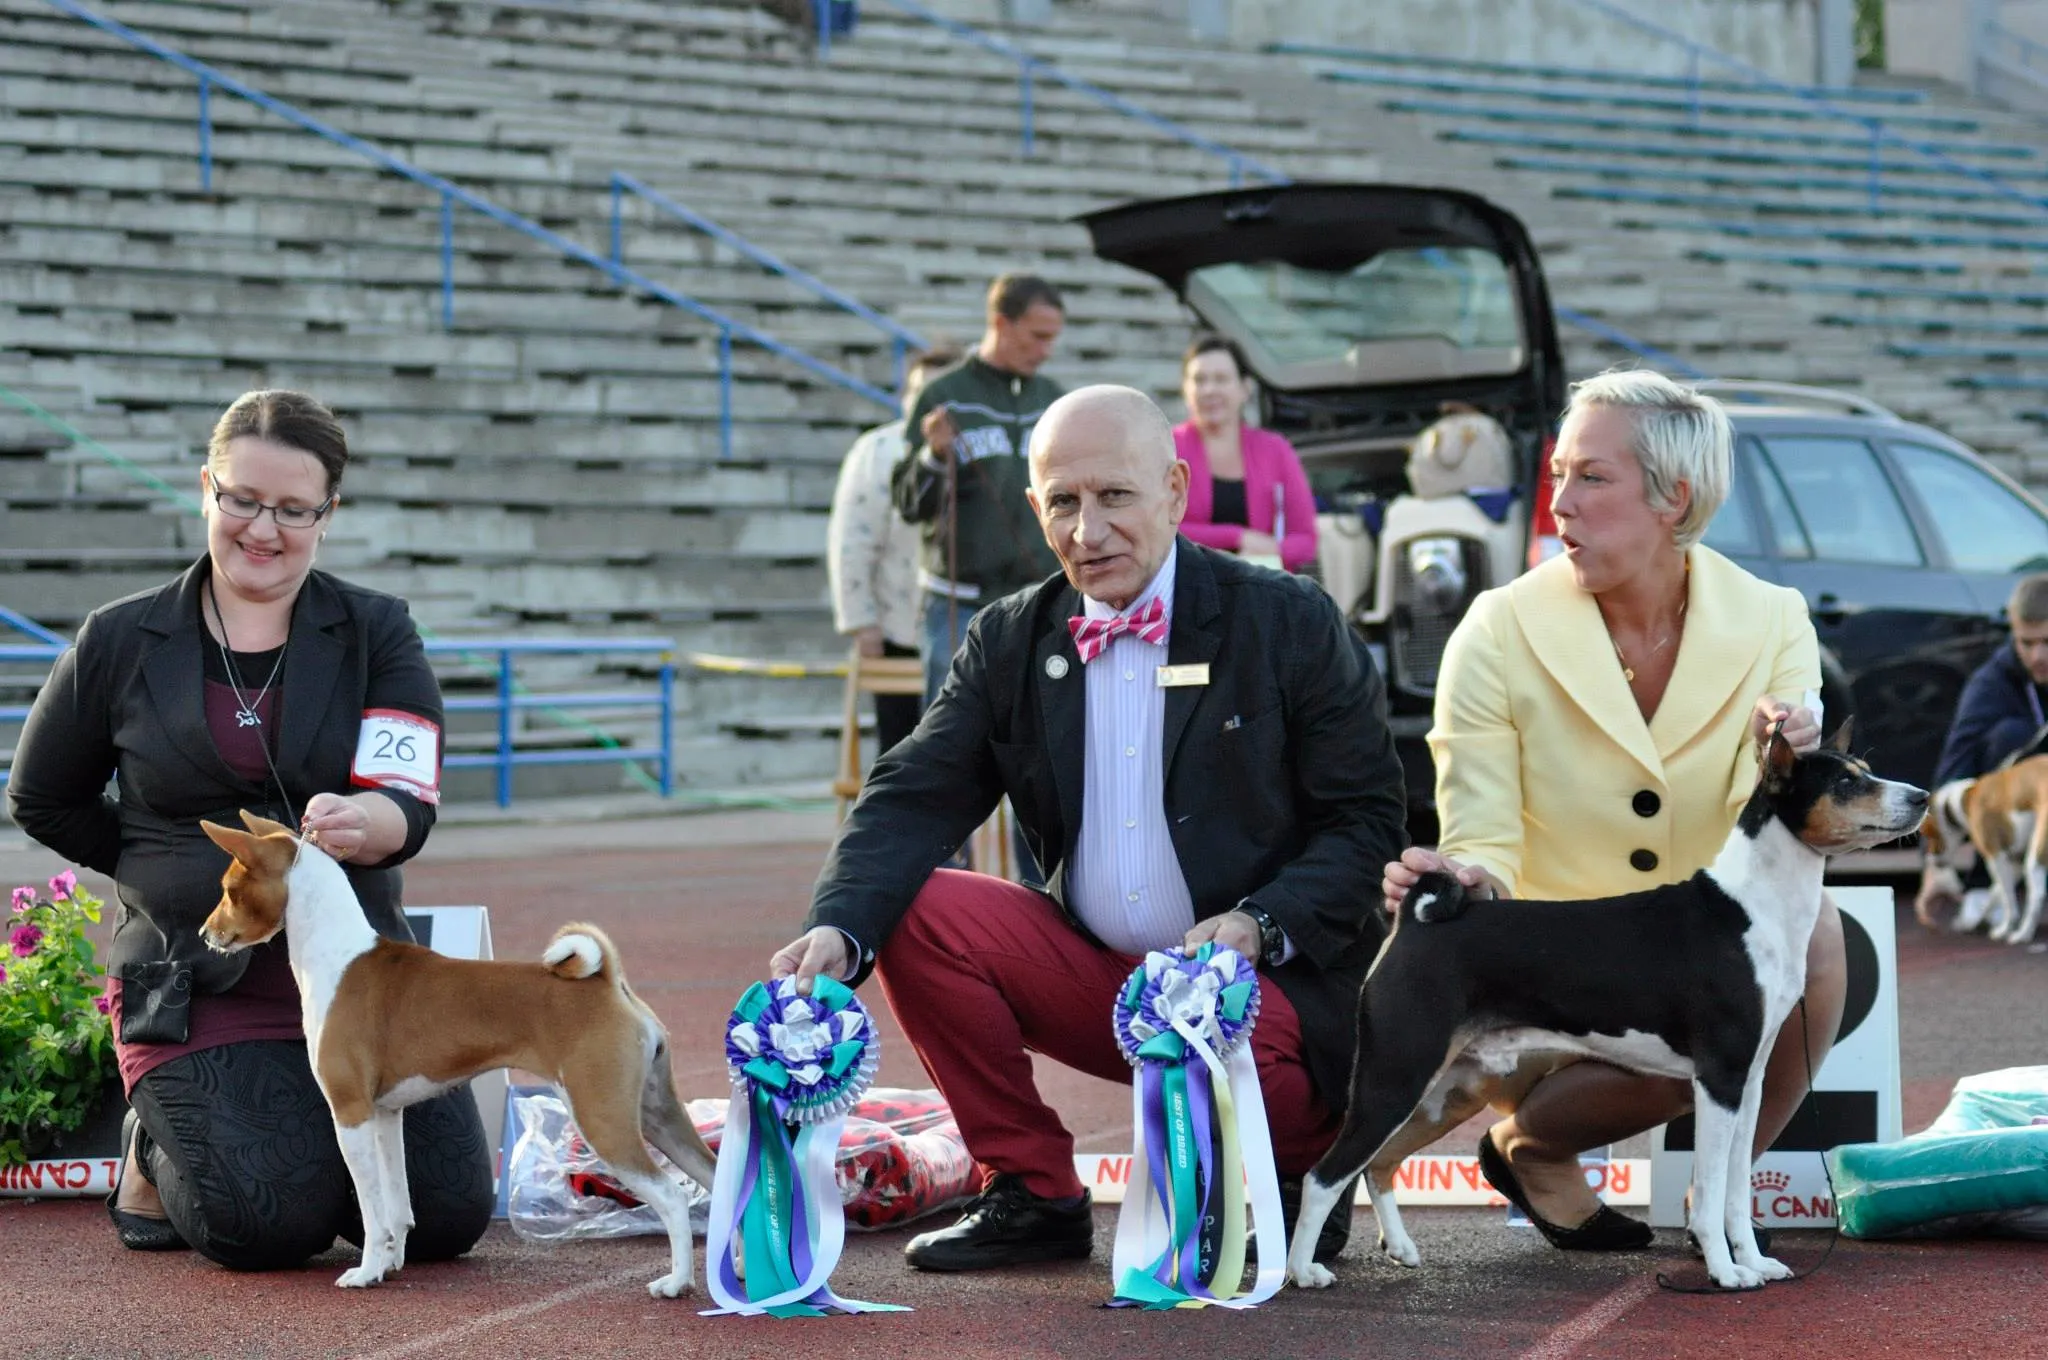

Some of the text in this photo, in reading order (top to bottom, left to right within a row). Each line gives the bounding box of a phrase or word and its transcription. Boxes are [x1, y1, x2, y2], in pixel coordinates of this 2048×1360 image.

[373, 730, 416, 762] 26
[1772, 1196, 1836, 1217] CANI
[1200, 1215, 1215, 1273] PAR
